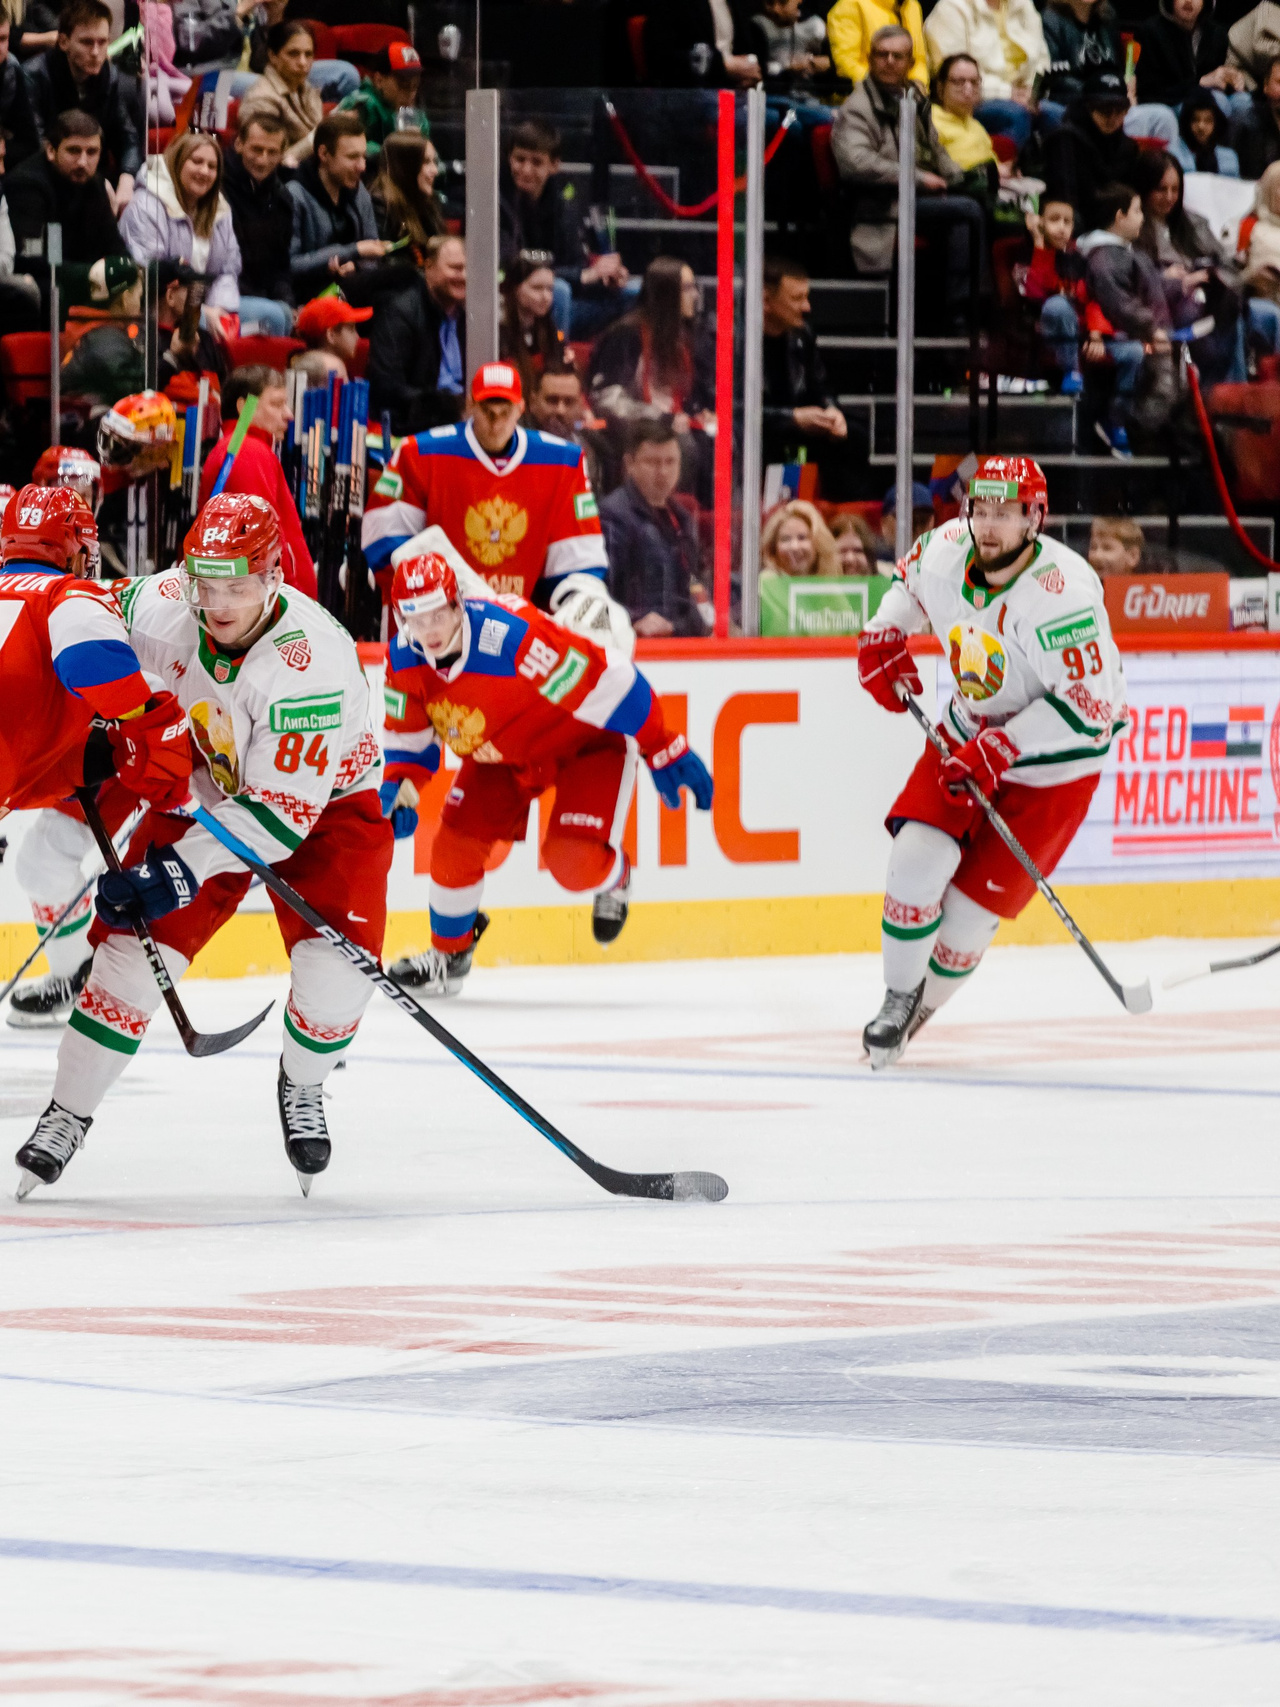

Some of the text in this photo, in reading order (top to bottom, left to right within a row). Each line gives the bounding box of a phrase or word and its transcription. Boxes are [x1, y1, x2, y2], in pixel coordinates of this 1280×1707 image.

[19, 507, 44, 526] 79
[203, 526, 229, 544] 84
[518, 636, 560, 681] 48
[1061, 640, 1103, 681] 93
[274, 731, 329, 777] 84
[1117, 705, 1188, 763] RED
[1113, 766, 1263, 826] MACHINE
